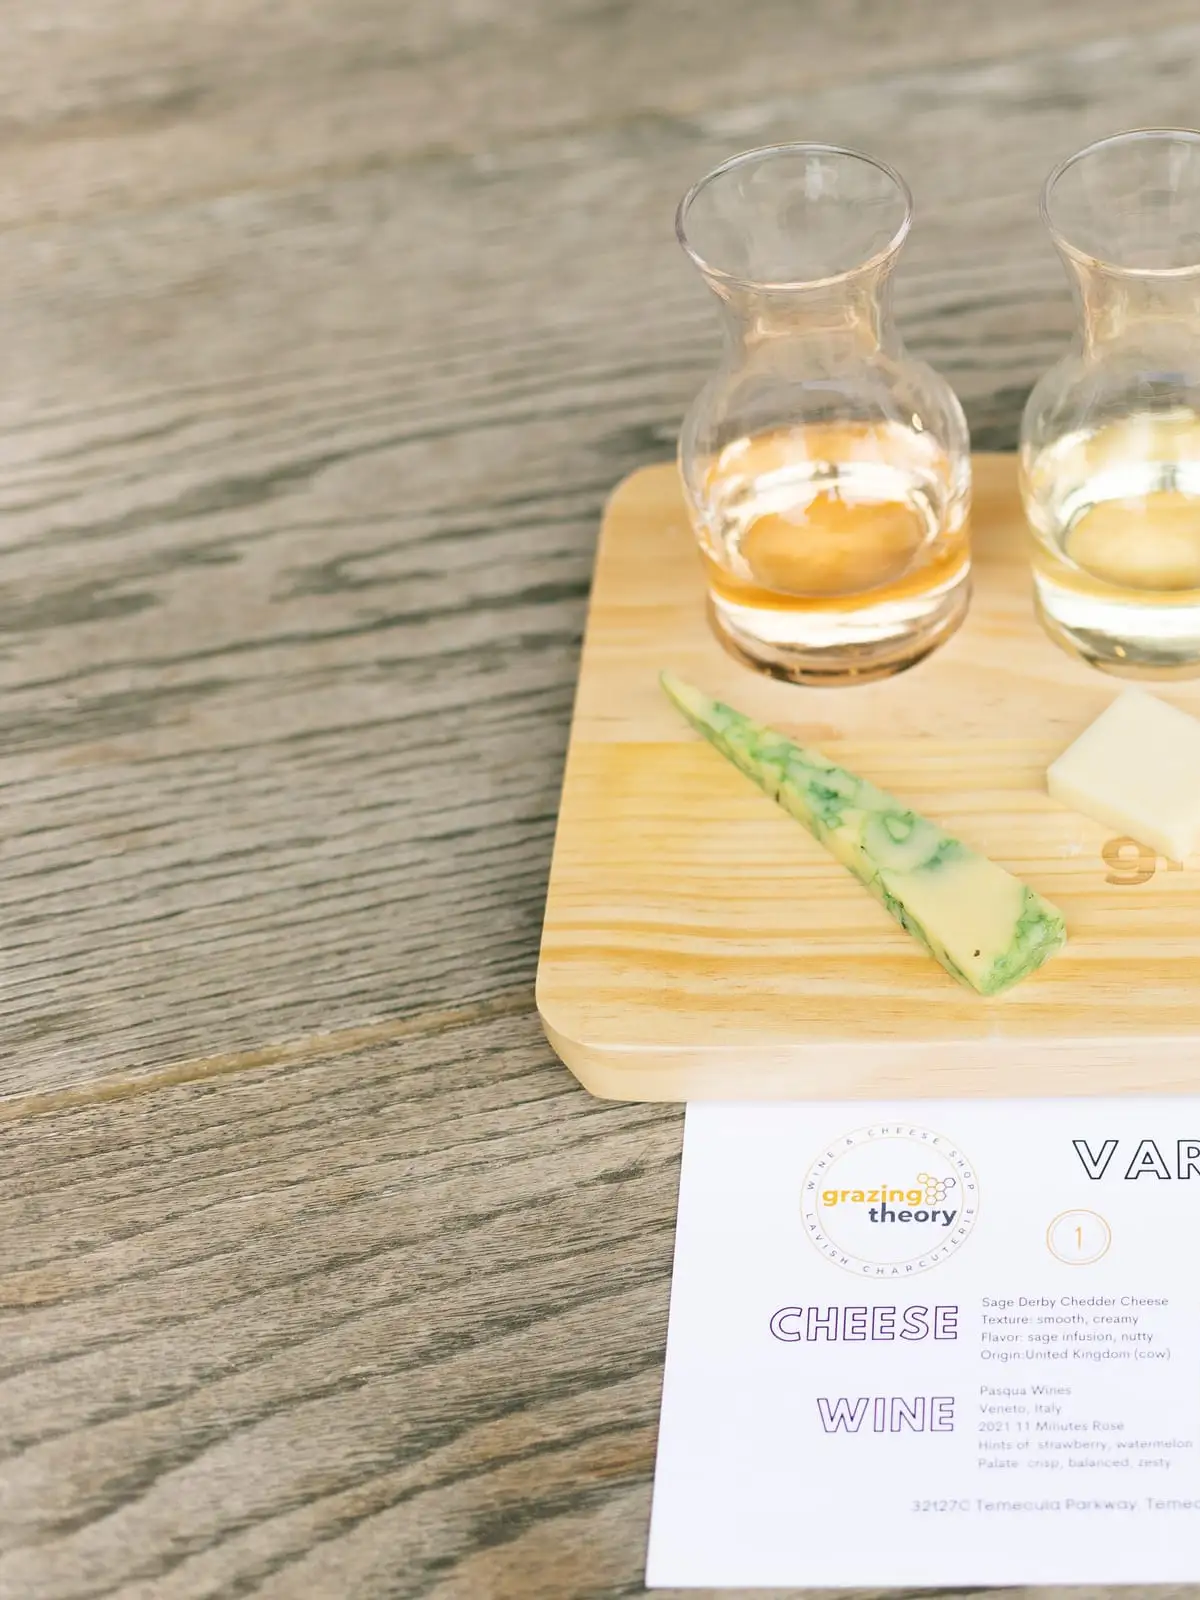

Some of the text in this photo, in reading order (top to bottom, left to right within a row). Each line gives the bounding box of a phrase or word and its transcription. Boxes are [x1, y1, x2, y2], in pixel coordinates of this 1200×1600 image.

[822, 1184, 922, 1207] grazing
[868, 1202, 957, 1227] theory
[981, 1295, 1169, 1311] Sage Derby Chedder Cheese
[769, 1305, 959, 1342] CHEESE
[1036, 1312, 1089, 1326] smooth,
[1092, 1315, 1139, 1327] creamy
[1027, 1333, 1059, 1345] sage
[1121, 1332, 1154, 1344] nutty
[1072, 1348, 1131, 1363] Kingdom
[1133, 1347, 1171, 1362] (cow)
[979, 1384, 1072, 1400] Pasqua Wines
[817, 1397, 955, 1432] WINE
[1034, 1401, 1063, 1417] Italy
[977, 1420, 1010, 1433] 2021
[978, 1439, 1014, 1452] Hints
